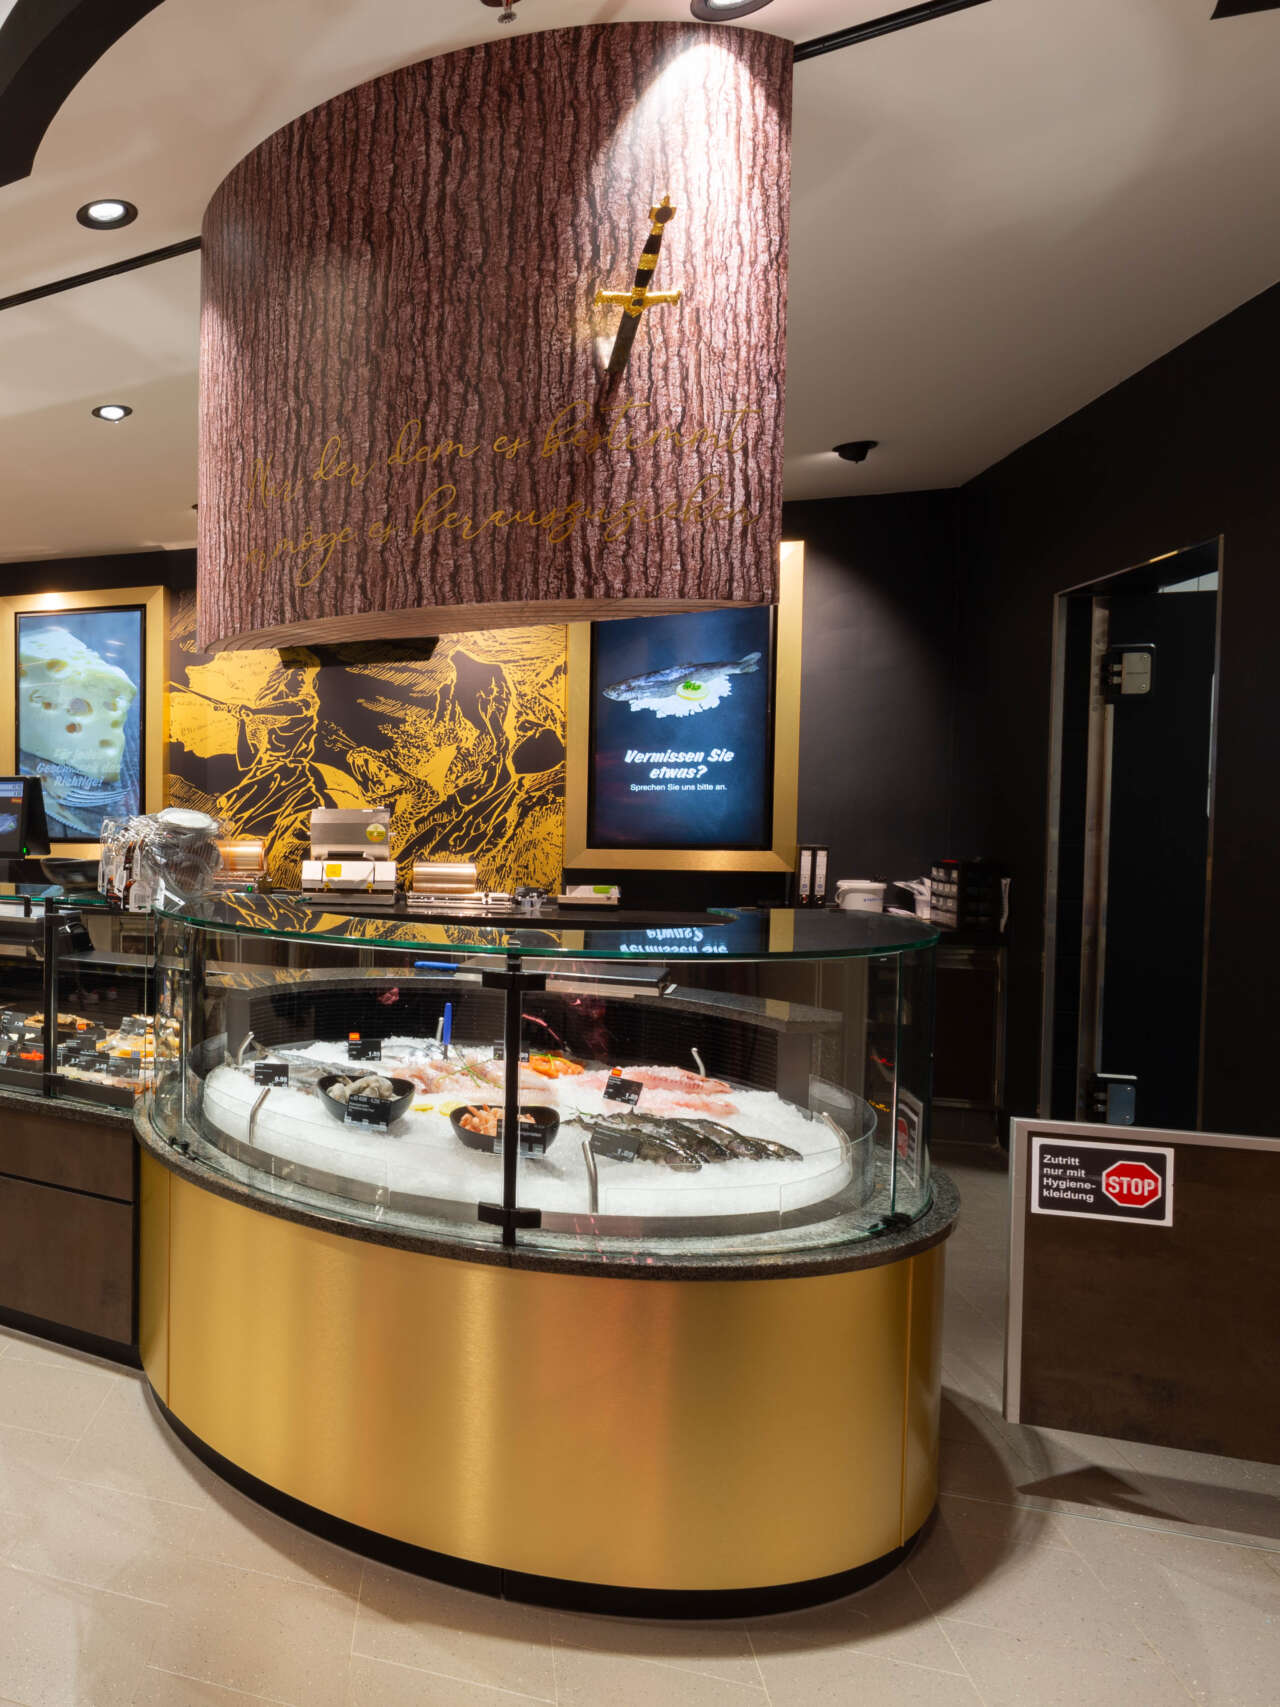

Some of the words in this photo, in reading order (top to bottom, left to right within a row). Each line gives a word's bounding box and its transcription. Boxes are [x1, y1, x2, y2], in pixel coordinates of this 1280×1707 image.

[313, 435, 375, 486] der
[387, 419, 481, 465] dem
[493, 435, 532, 459] es
[540, 398, 762, 457] bestimmt
[624, 749, 705, 763] Vermissen
[707, 748, 735, 762] Sie
[649, 765, 708, 779] etwas?
[630, 783, 665, 793] Sprechen
[667, 783, 680, 791] Sie
[697, 783, 714, 791] bitte
[1042, 1154, 1080, 1166] Zutritt
[1043, 1167, 1063, 1176] nur
[1066, 1168, 1086, 1178] mit
[1043, 1177, 1097, 1190] Hygiene-
[1108, 1176, 1155, 1197] STOP
[1042, 1189, 1095, 1203] kleidung
